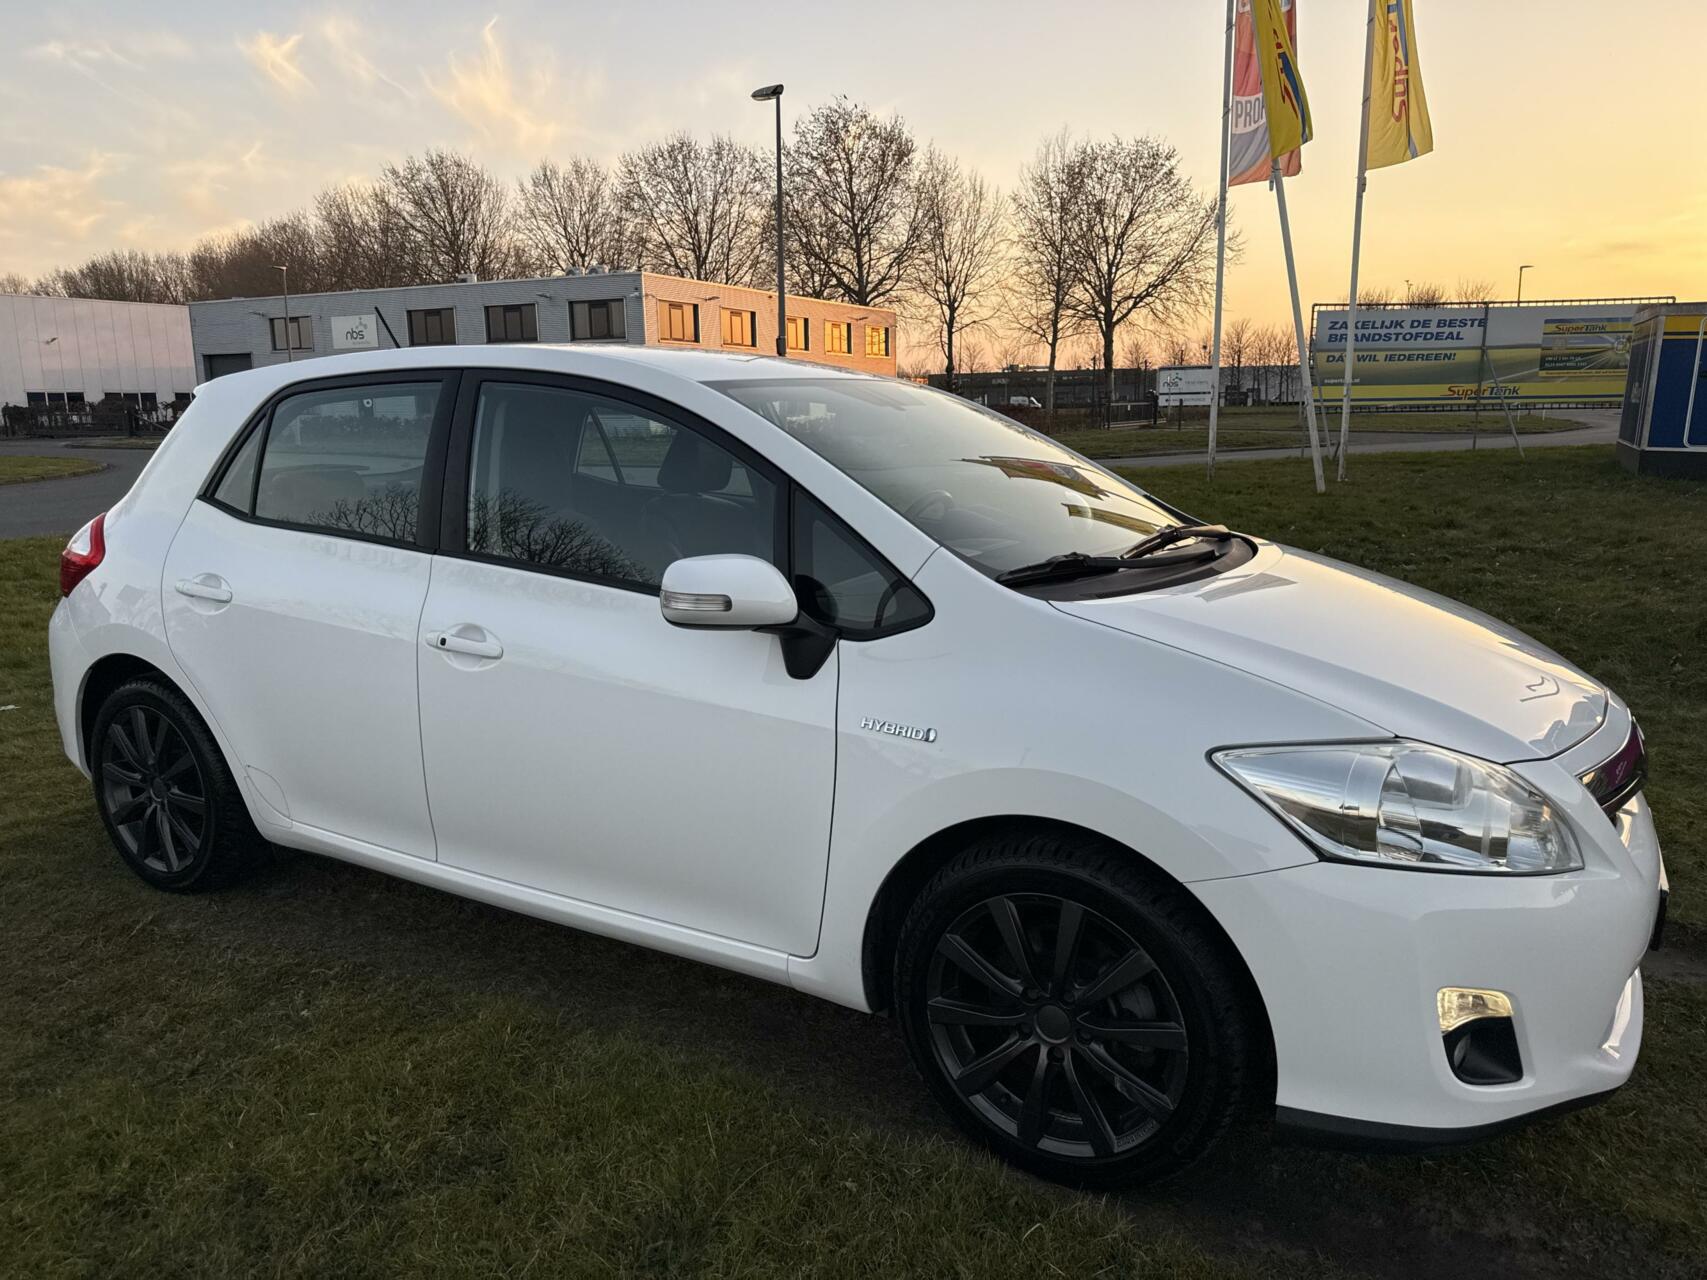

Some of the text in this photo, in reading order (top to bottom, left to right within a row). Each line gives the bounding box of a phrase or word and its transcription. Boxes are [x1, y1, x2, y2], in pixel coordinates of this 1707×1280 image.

[1328, 317, 1489, 331] ZAKELIJK DE BESTE
[345, 328, 365, 340] nbs
[1356, 354, 1379, 363] WIL
[1384, 352, 1457, 362] IEDEREEN!
[1446, 385, 1521, 400] SuperTank
[860, 717, 925, 741] HYBRID
